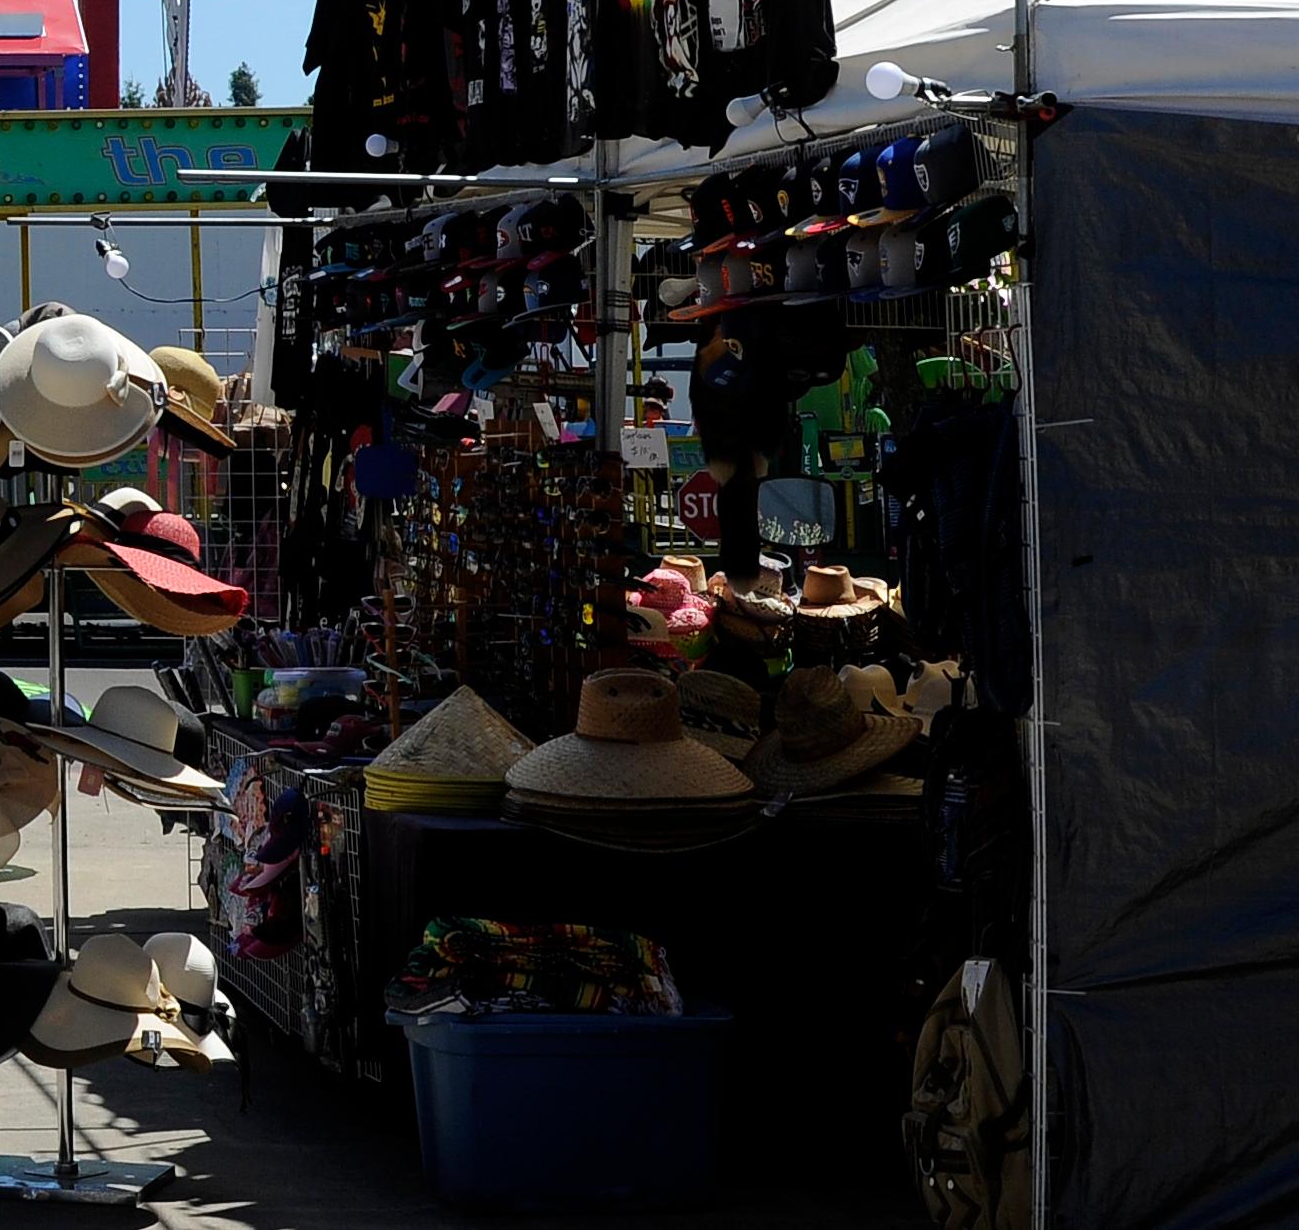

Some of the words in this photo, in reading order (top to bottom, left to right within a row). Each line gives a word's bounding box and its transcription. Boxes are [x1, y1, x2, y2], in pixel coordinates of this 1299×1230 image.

[102, 135, 258, 186] the
[803, 443, 812, 475] YES
[684, 492, 718, 518] ST
